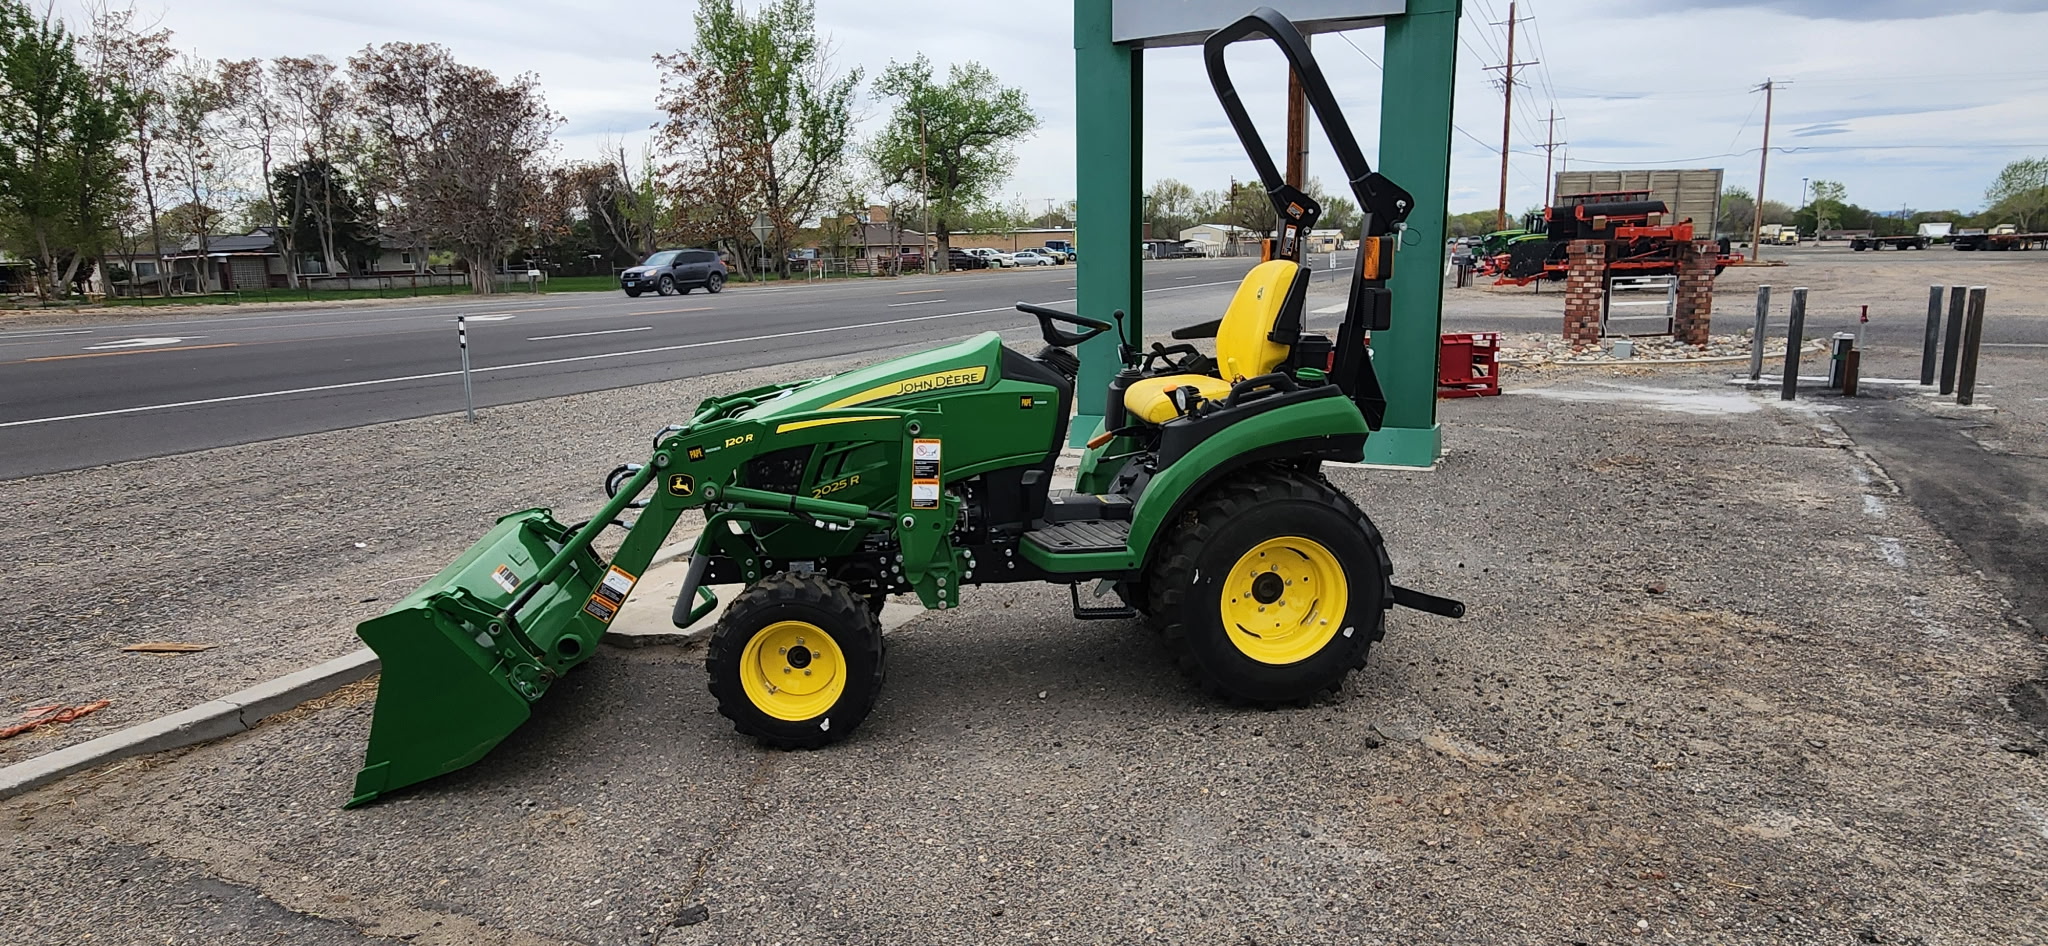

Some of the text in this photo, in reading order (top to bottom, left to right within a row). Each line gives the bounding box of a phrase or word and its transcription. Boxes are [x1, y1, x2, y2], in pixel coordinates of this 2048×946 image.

[896, 372, 979, 395] JOHN DEERE
[725, 433, 754, 448] 120 R
[812, 474, 860, 499] 2025 R
